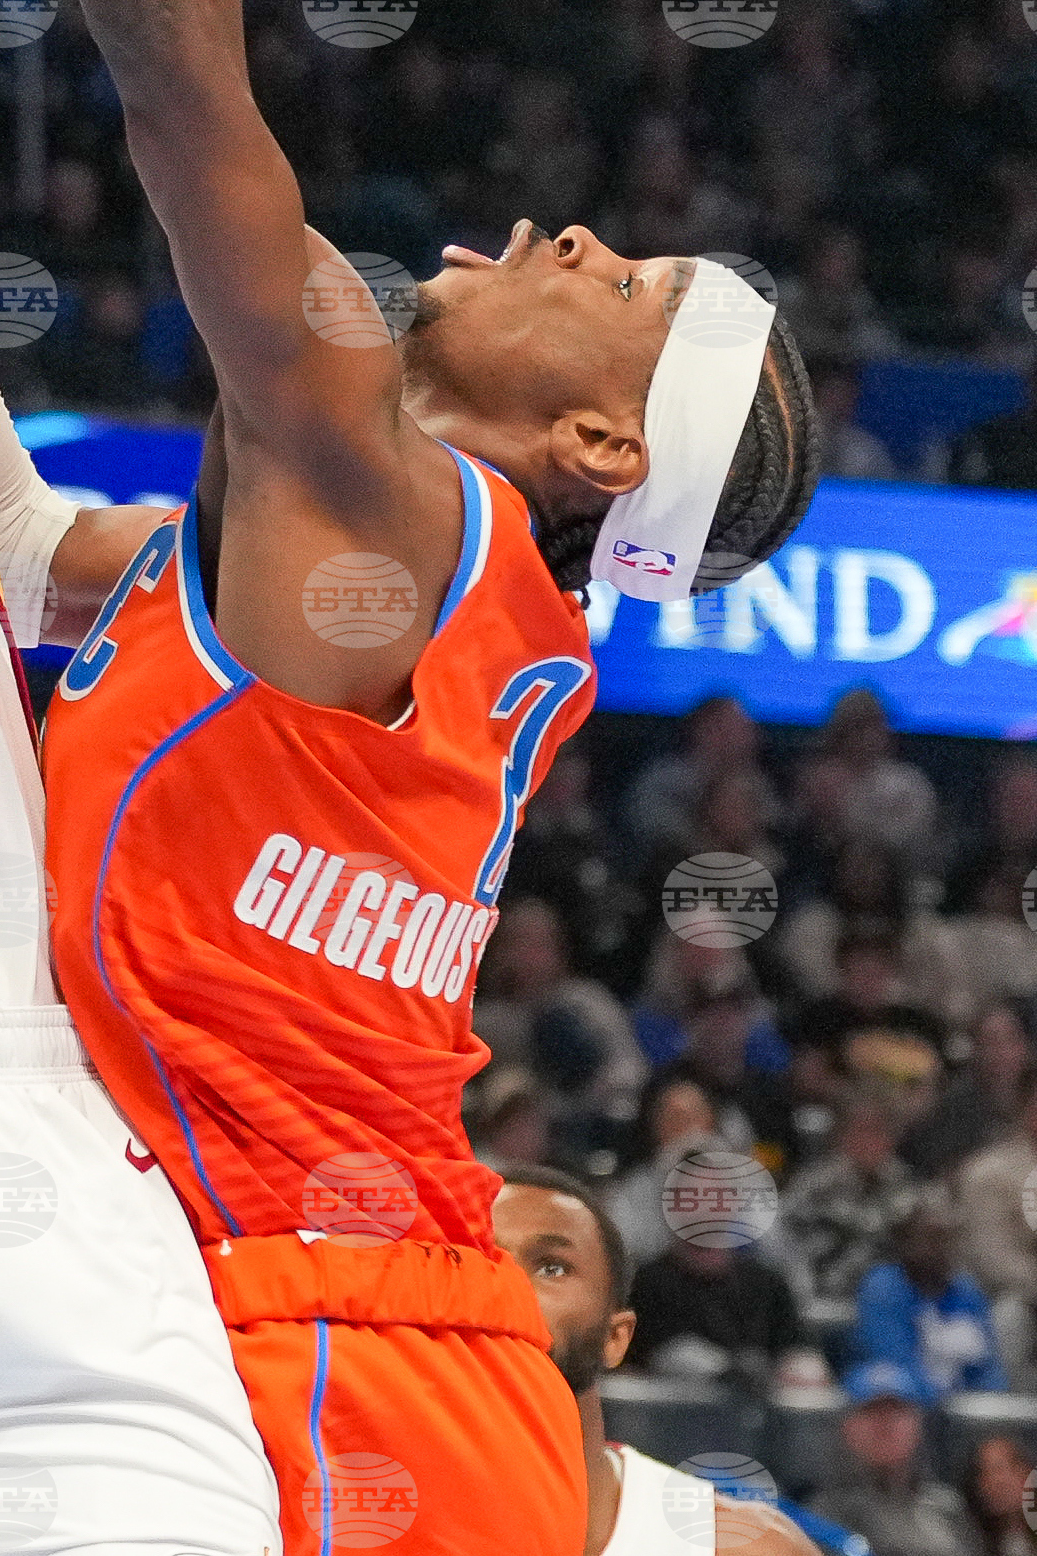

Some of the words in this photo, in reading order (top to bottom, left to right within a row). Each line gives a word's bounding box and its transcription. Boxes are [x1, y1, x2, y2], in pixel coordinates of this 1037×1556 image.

[587, 543, 938, 665] IND
[471, 656, 592, 907] 2
[233, 833, 491, 1004] GILGEOUS
